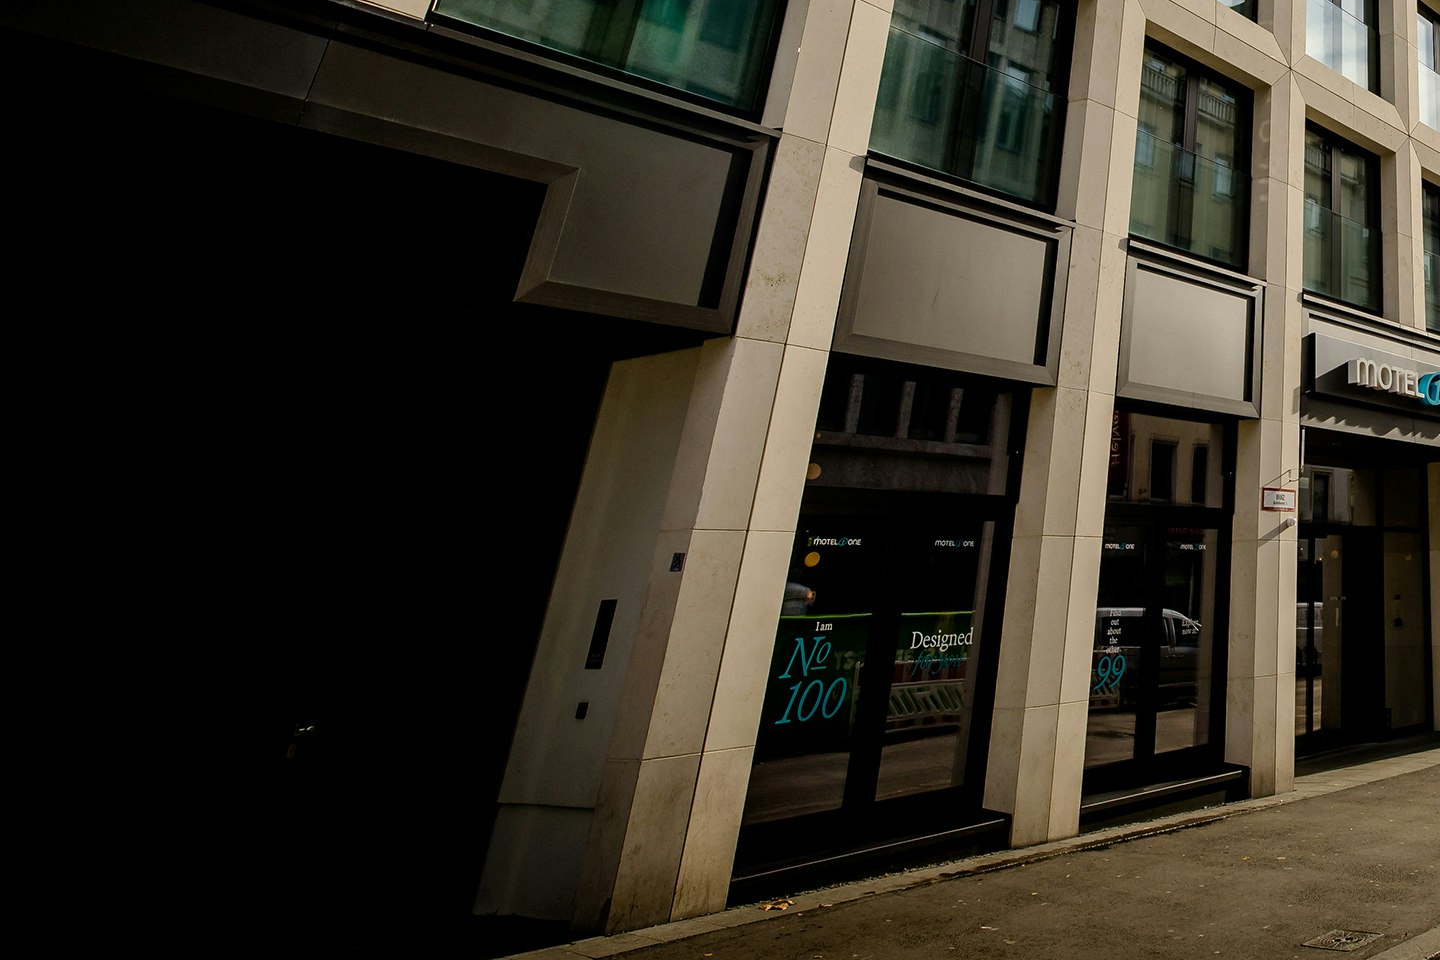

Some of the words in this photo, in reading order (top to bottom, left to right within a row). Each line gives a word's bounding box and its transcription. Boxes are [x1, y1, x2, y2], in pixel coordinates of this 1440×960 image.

[1353, 357, 1425, 399] MOTEL
[934, 539, 956, 547] MOTEL
[820, 622, 833, 631] am
[910, 627, 974, 652] Designed
[1093, 655, 1127, 690] 99
[775, 677, 848, 725] 100
